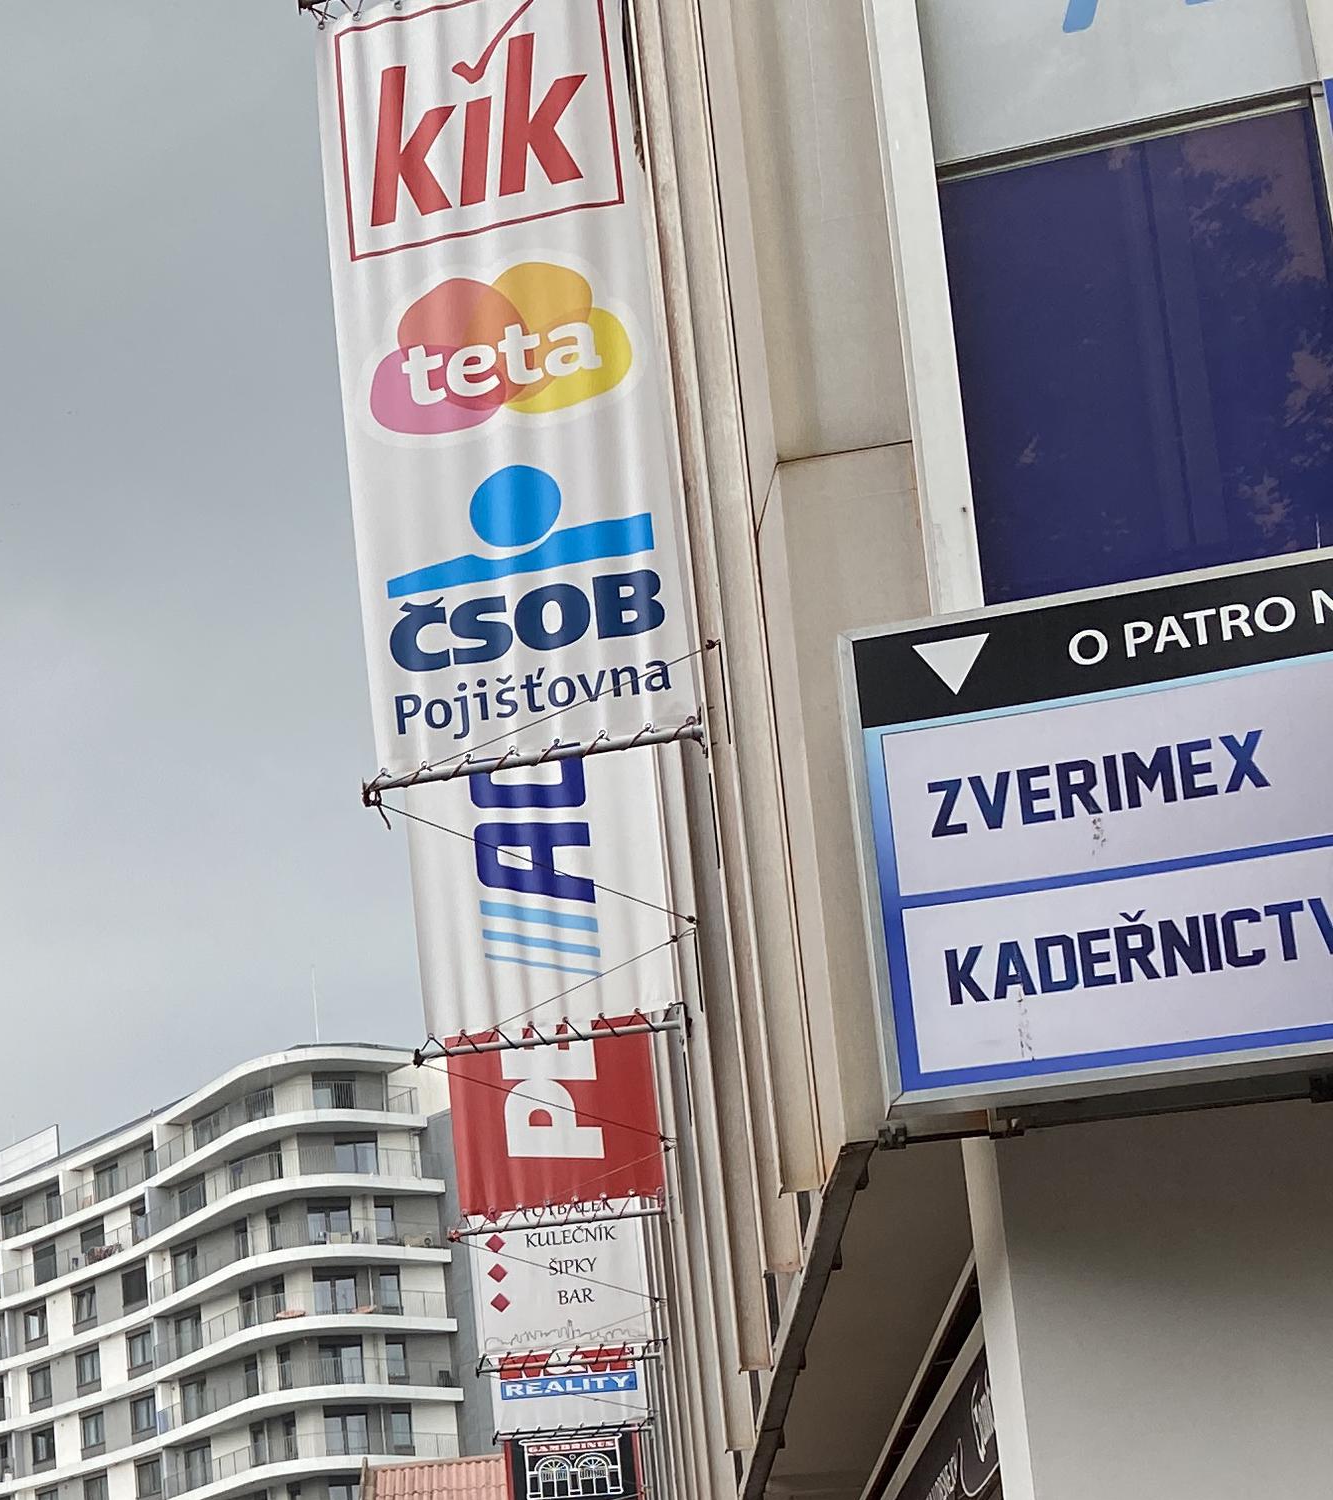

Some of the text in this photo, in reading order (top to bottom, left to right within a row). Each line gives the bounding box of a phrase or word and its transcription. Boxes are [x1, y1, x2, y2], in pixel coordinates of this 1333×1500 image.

[370, 14, 587, 228] kik
[401, 319, 601, 408] teta
[389, 567, 666, 674] ČSOB
[1068, 628, 1110, 667] O
[1125, 595, 1297, 659] PATRO
[394, 655, 673, 741] Pojišťovna
[927, 728, 1272, 839] ZVERIMEX
[525, 1223, 617, 1248] KULEČNÍK
[548, 1256, 598, 1277] ŠIPKY
[558, 1287, 596, 1306] BAR
[505, 1374, 630, 1397] REALITY
[527, 1439, 616, 1454] GAMBRINUS
